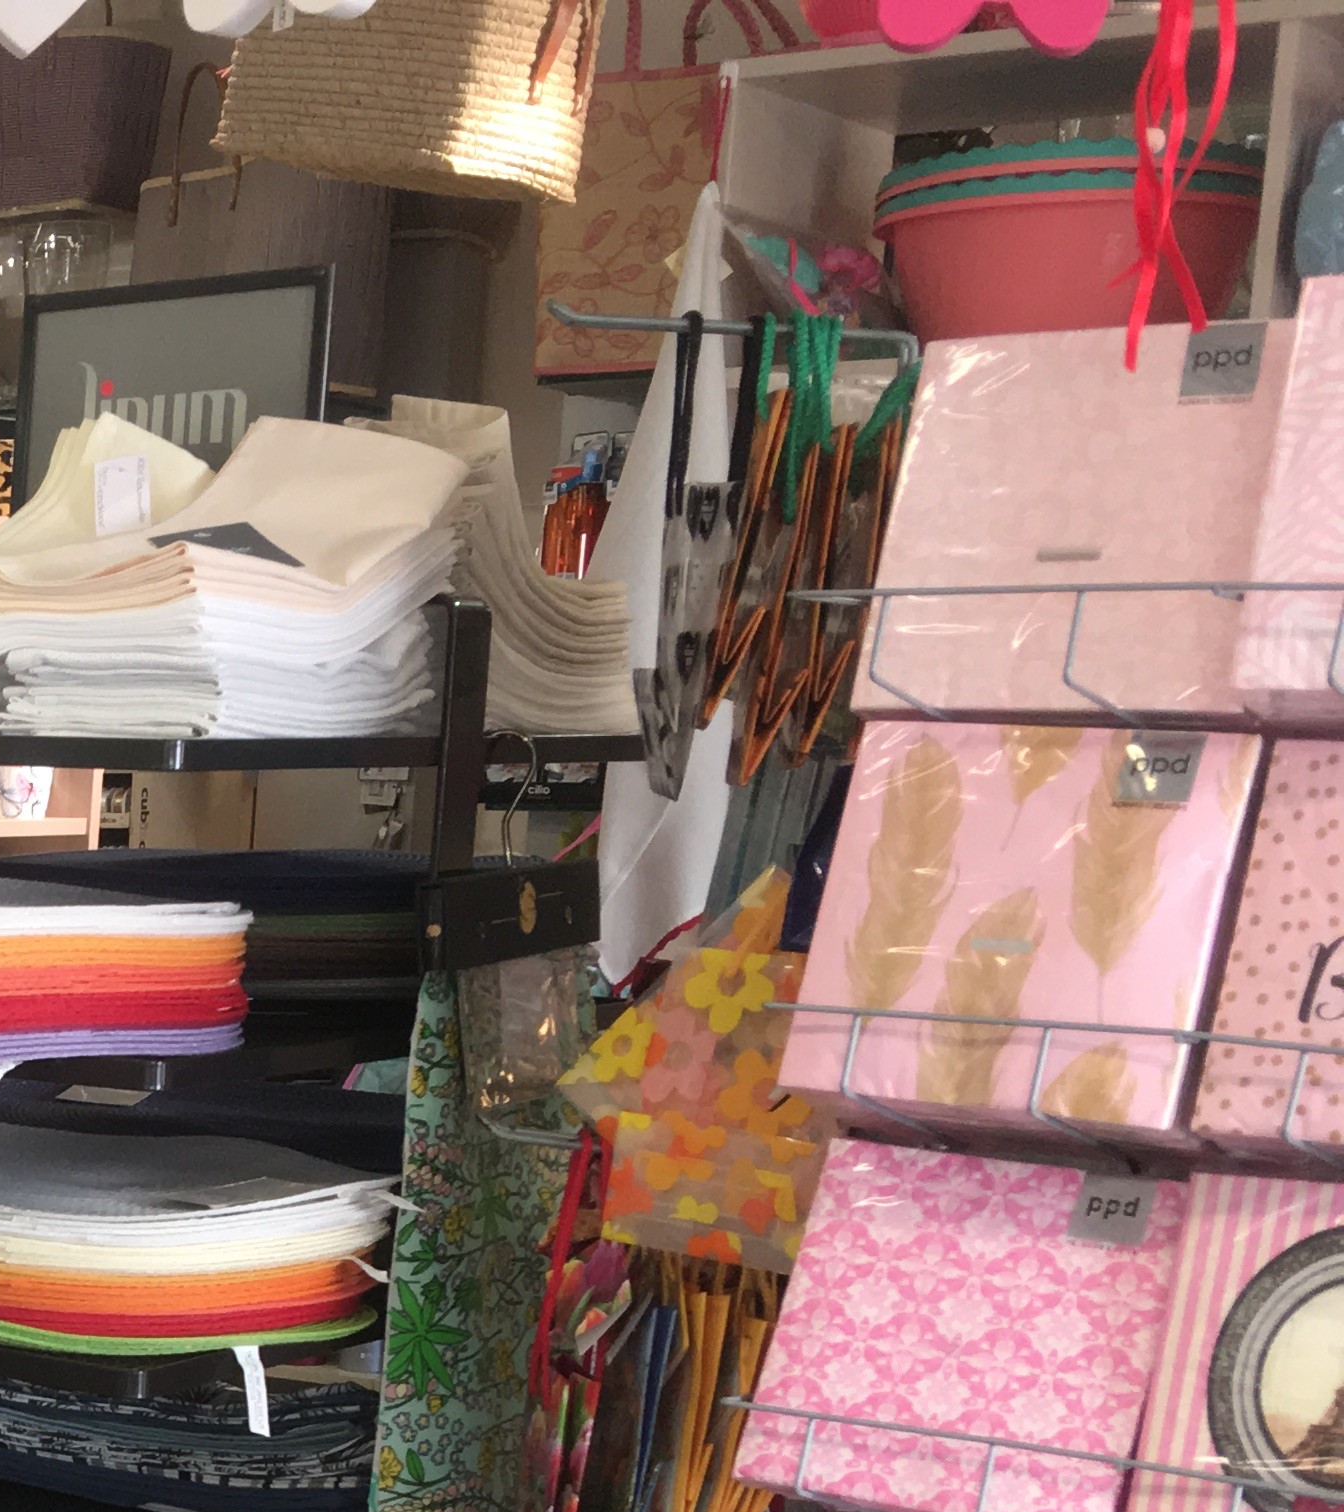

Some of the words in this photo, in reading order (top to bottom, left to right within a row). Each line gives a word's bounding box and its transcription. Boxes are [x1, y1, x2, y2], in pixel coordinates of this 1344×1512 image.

[1193, 344, 1254, 372] ppd
[1130, 752, 1191, 776] ppd
[1085, 1196, 1141, 1220] ppd
